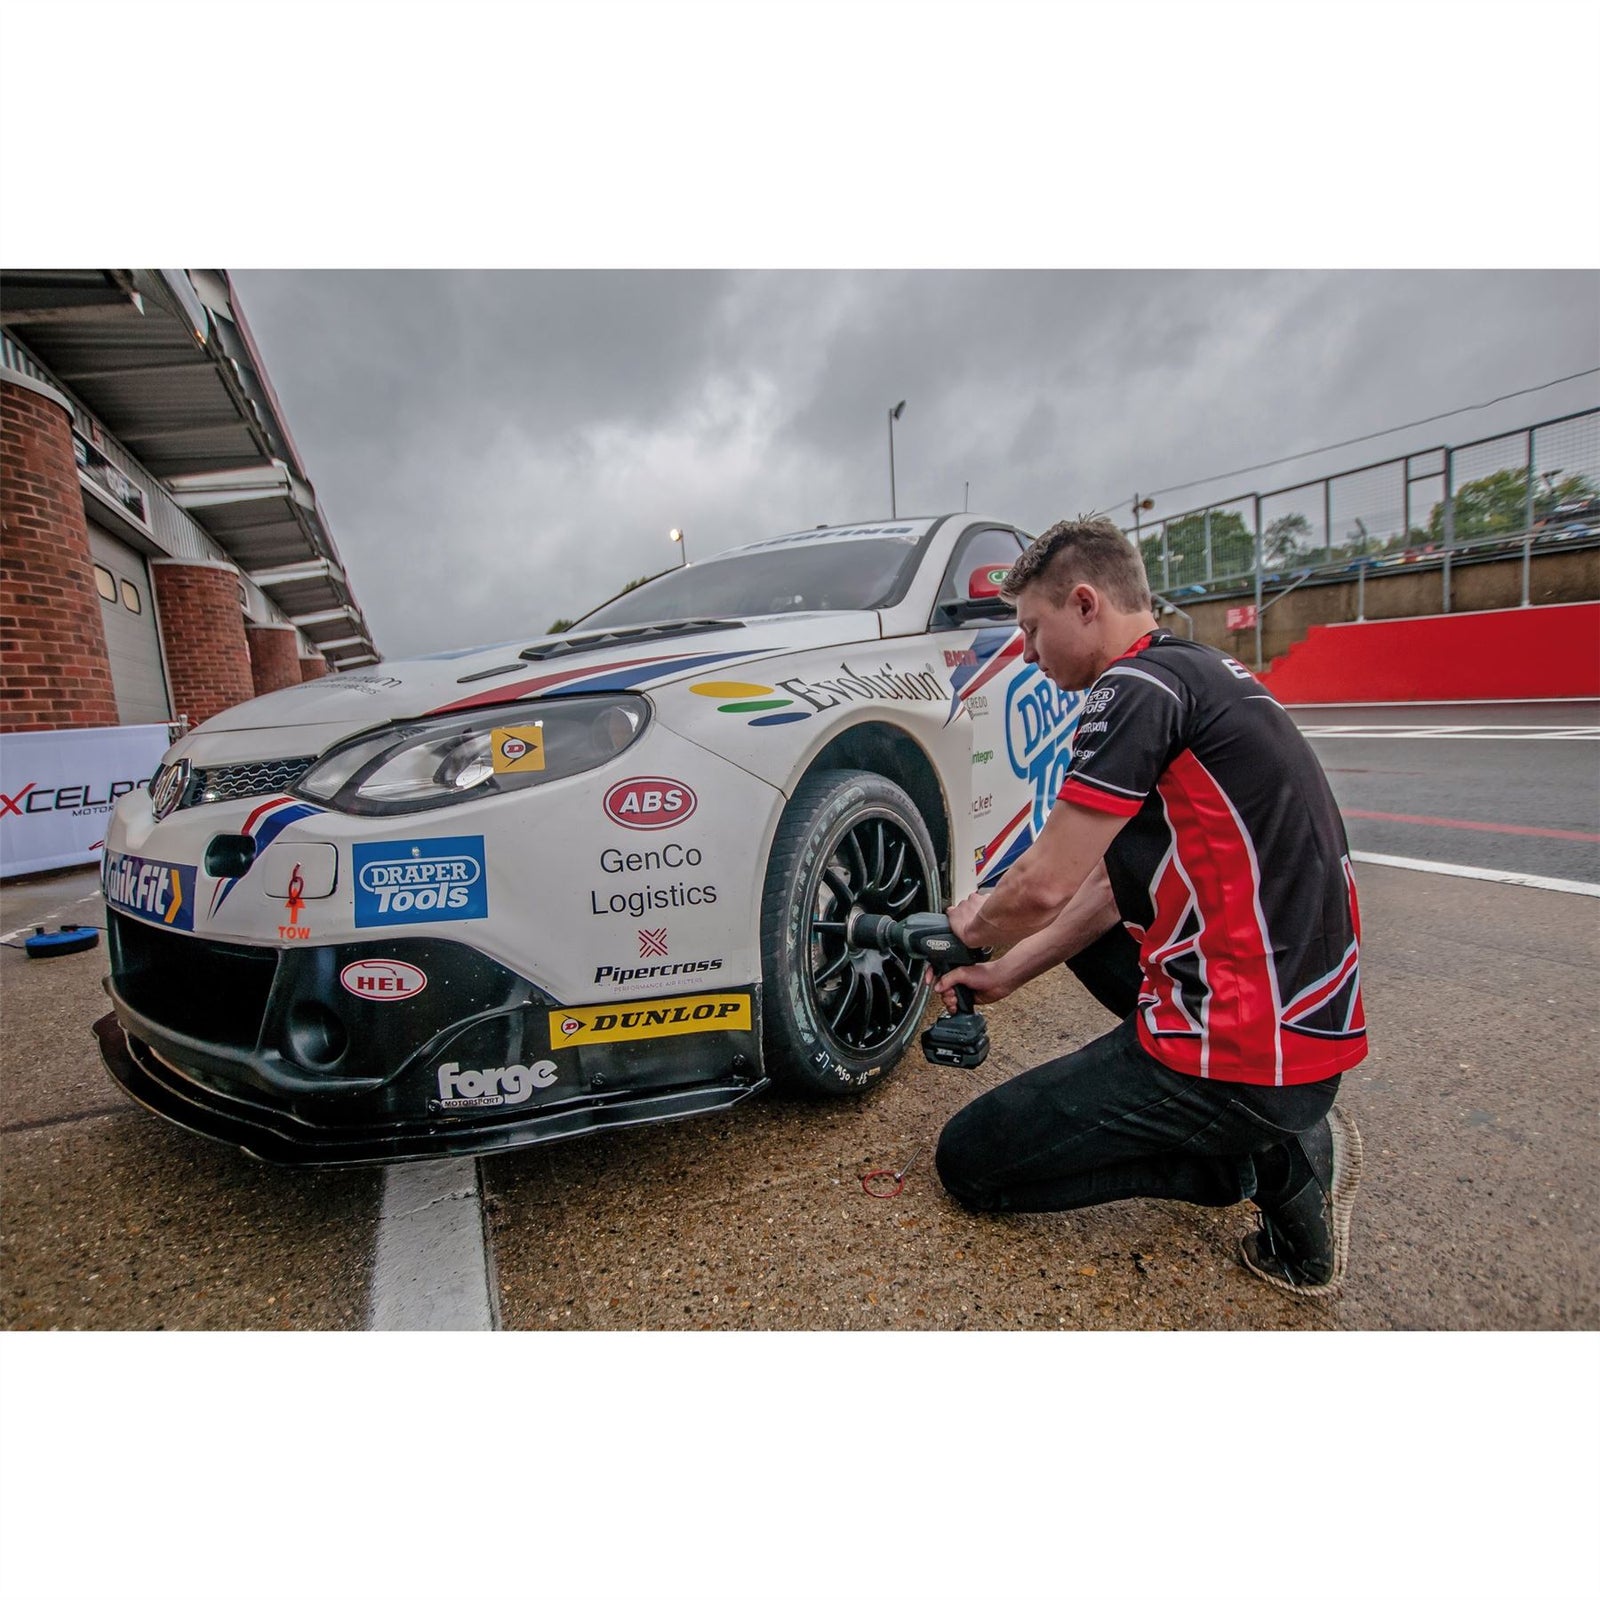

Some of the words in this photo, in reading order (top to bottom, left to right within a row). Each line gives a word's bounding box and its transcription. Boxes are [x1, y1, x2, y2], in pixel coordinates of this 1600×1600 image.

[775, 662, 951, 713] Evolution
[1017, 678, 1091, 758] DRA
[0, 779, 151, 819] XCELR
[72, 805, 114, 817] MOTOR
[618, 789, 683, 815] ABS
[600, 843, 702, 874] GenCo
[371, 862, 469, 886] DRAPER
[374, 881, 469, 913] Tools
[591, 882, 717, 917] Logistics
[278, 926, 311, 940] TOW
[357, 976, 411, 991] HEL
[594, 958, 723, 985] Pipercross
[590, 1003, 741, 1032] DUNLOP
[444, 1098, 499, 1107] MOTORSPORT
